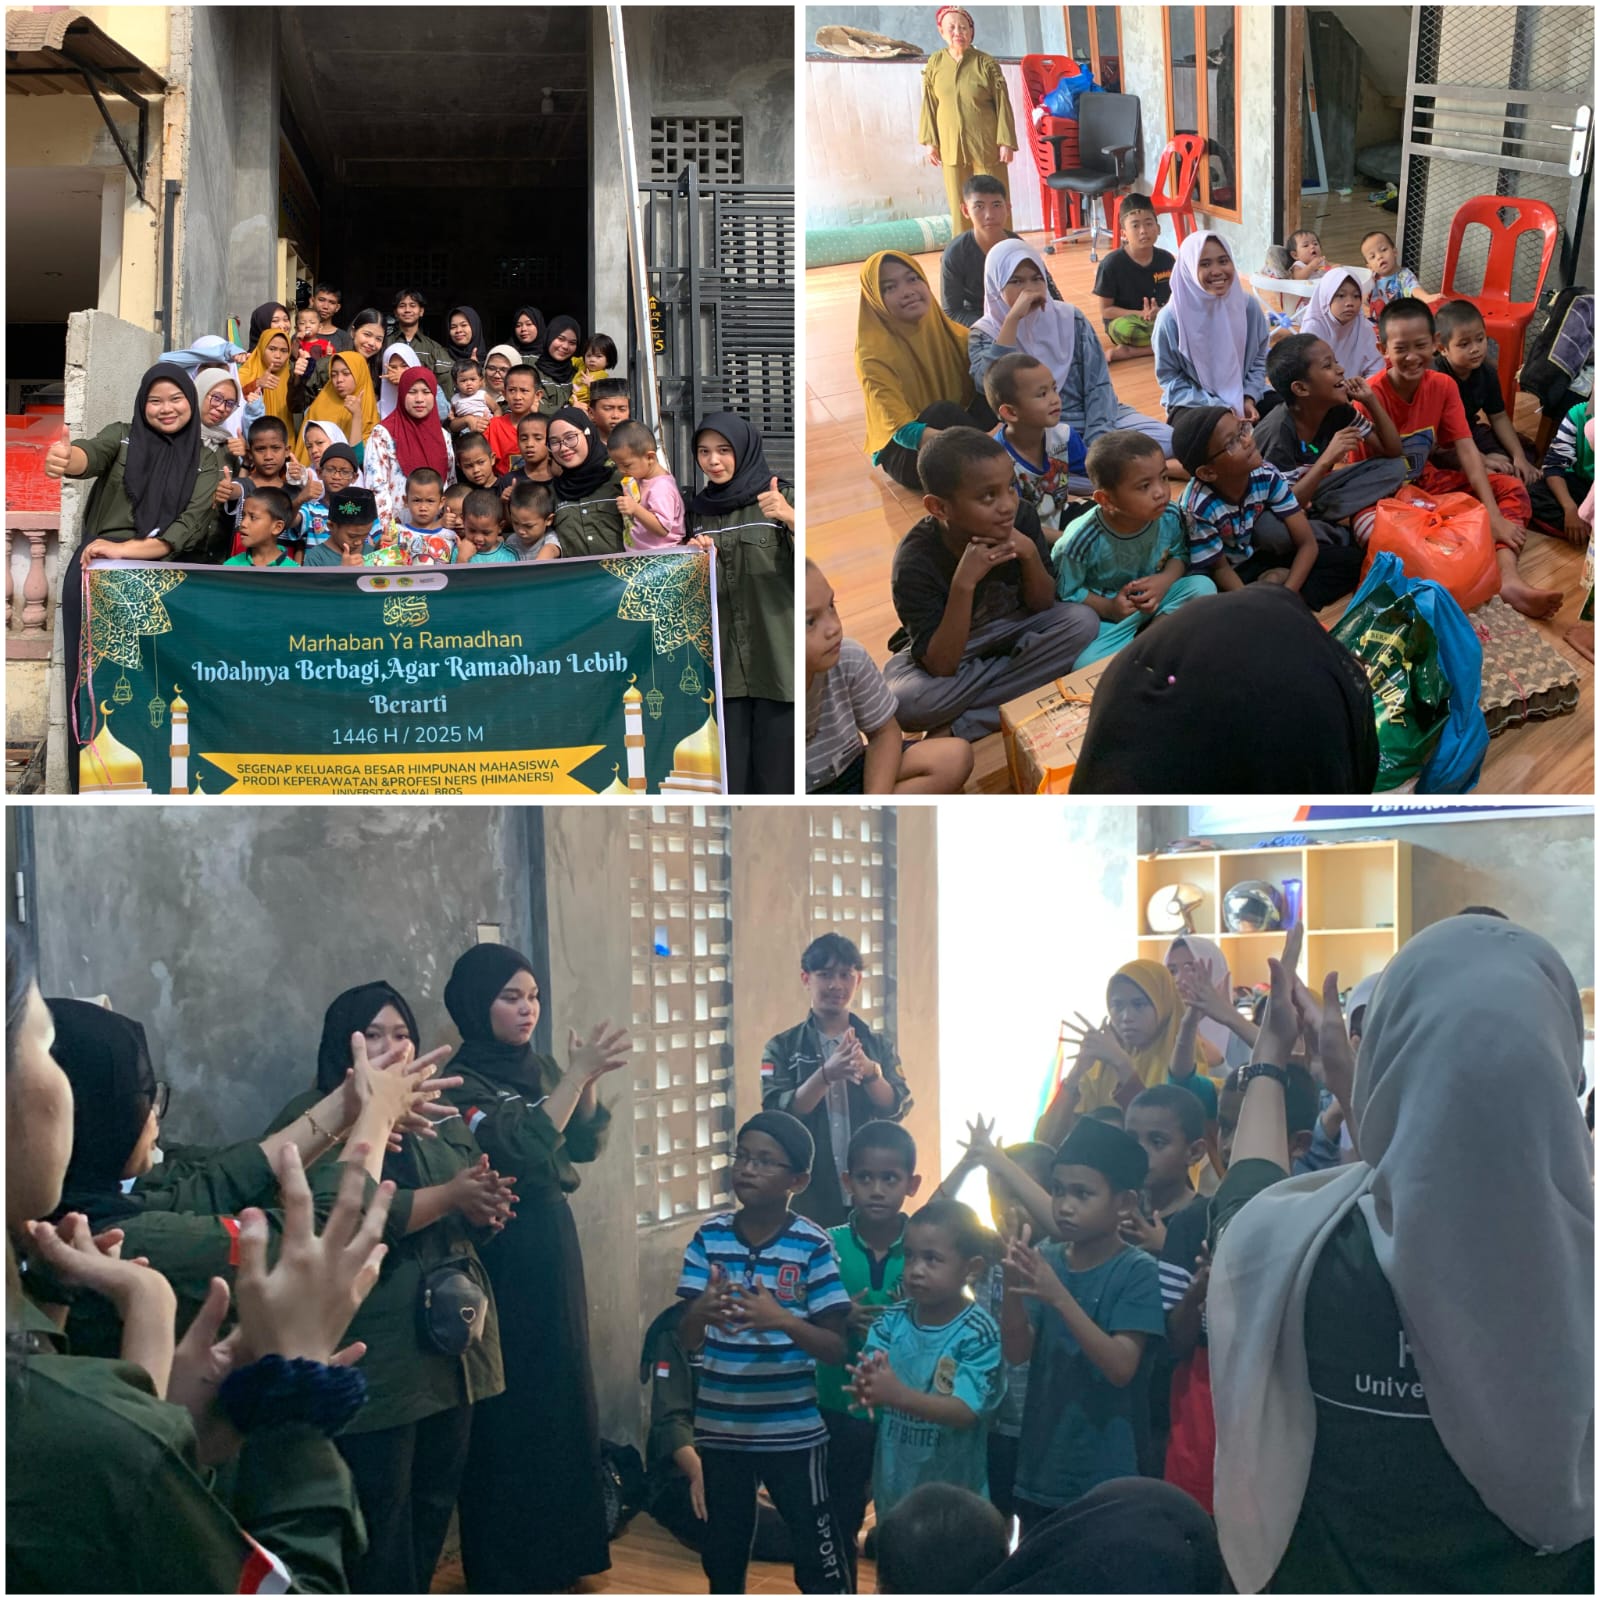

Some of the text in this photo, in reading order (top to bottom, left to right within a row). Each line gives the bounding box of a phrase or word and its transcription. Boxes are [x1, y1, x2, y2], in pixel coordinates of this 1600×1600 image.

[289, 630, 523, 652] Marhaban Ya Ramadhan
[191, 660, 290, 686] Indahnya
[444, 654, 561, 681] Ramadhan
[566, 651, 628, 674] Lebih
[369, 694, 448, 715] Berarti
[1366, 666, 1407, 727] ETUPAT
[332, 726, 484, 745] 1446 H / 2025 M
[237, 760, 560, 775] SEGENAP KELUARGA BESAR HIMPUNAN MAHASISWA
[242, 771, 554, 787] PRODI KEPERAWATAN &PROFESI NERS (HIMANERS)
[434, 787, 463, 795] BROS
[776, 1263, 801, 1301] 9
[816, 1512, 841, 1579] SPORT
